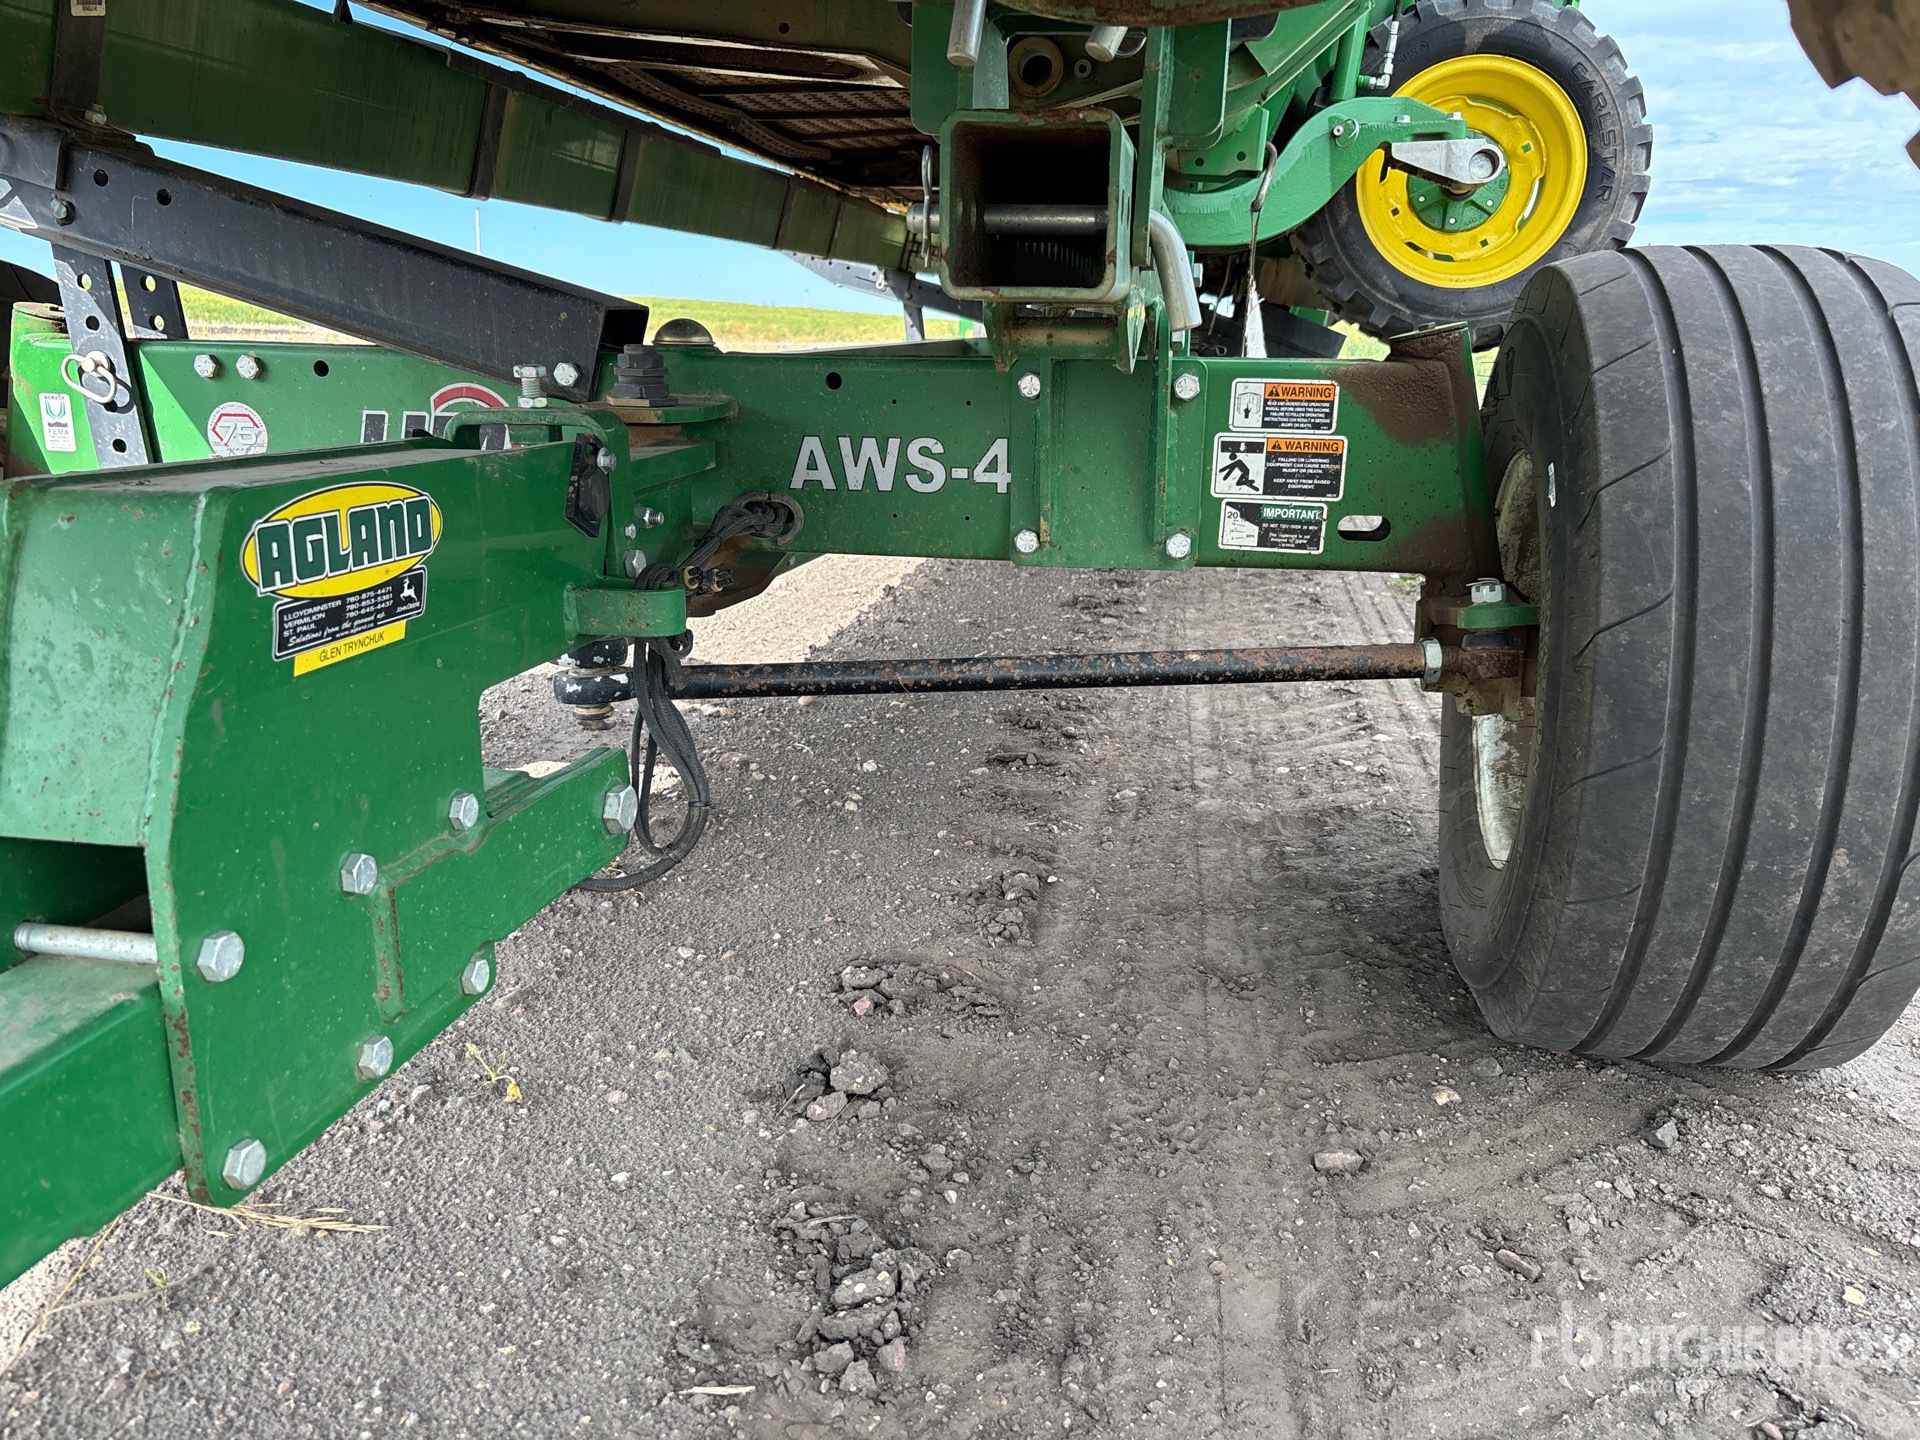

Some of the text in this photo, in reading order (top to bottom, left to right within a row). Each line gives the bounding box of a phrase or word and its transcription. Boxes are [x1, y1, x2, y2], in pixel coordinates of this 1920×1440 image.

[1570, 62, 1617, 205] CARLSTAR
[1281, 386, 1332, 398] WARNING
[218, 422, 258, 446] 75
[1285, 441, 1339, 452] WARNING
[788, 434, 1012, 494] AWS-4
[1227, 511, 1239, 519] 20
[1263, 507, 1321, 520] IMPORTANT
[256, 497, 433, 591] AGLAND
[283, 593, 393, 629] VERMILION 780-853-5361
[283, 600, 393, 638] ST. PAUL 780-645-4437
[284, 586, 392, 621] LLOYDMINSTER 780-875-4471
[395, 605, 408, 614] JOHN
[288, 631, 322, 647] Solutions
[323, 626, 339, 640] from
[341, 619, 351, 630] the
[353, 613, 375, 627] ground
[335, 622, 375, 638] www.agland.ca
[319, 631, 385, 662] GLEN TRYNCHUK
